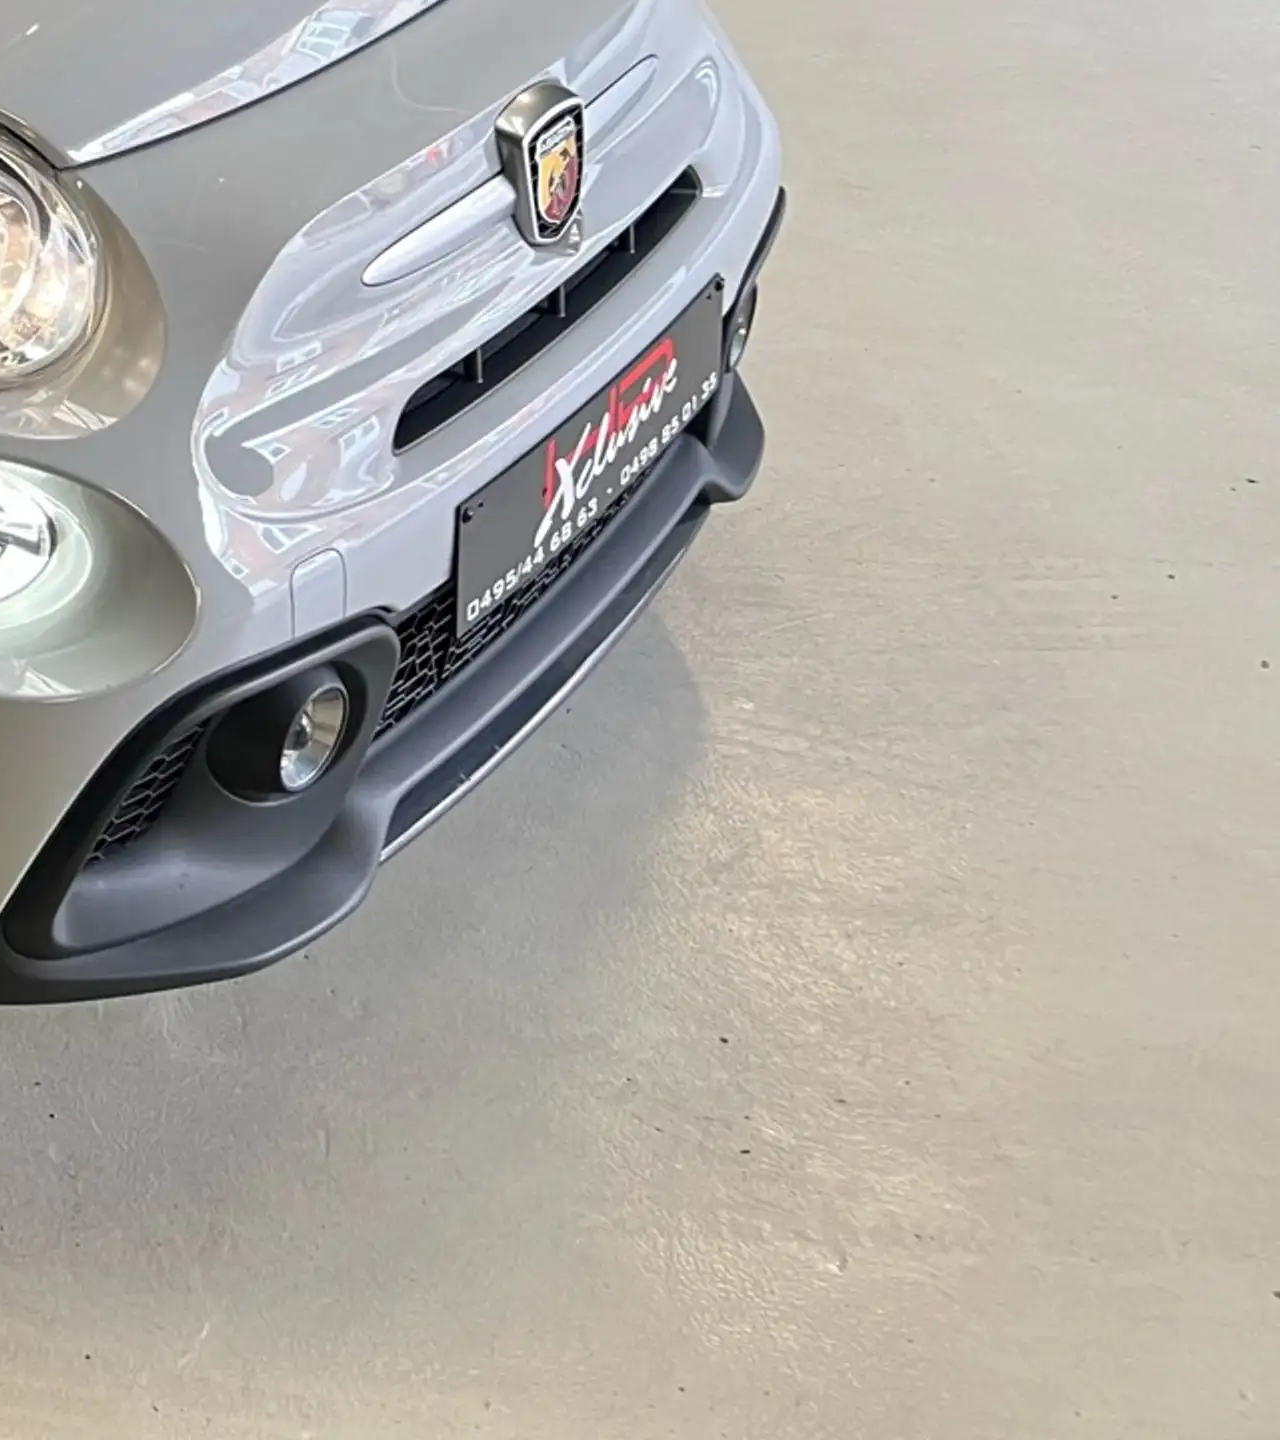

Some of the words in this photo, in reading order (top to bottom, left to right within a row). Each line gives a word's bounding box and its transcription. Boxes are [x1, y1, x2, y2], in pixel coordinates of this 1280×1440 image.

[466, 544, 545, 622] 0495/44
[549, 520, 572, 553] 68
[576, 496, 598, 528] 63
[620, 436, 658, 486] 0498
[661, 414, 680, 444] 85
[681, 394, 697, 422] 01
[701, 370, 717, 401] 35
[533, 357, 678, 549] Xclusive
